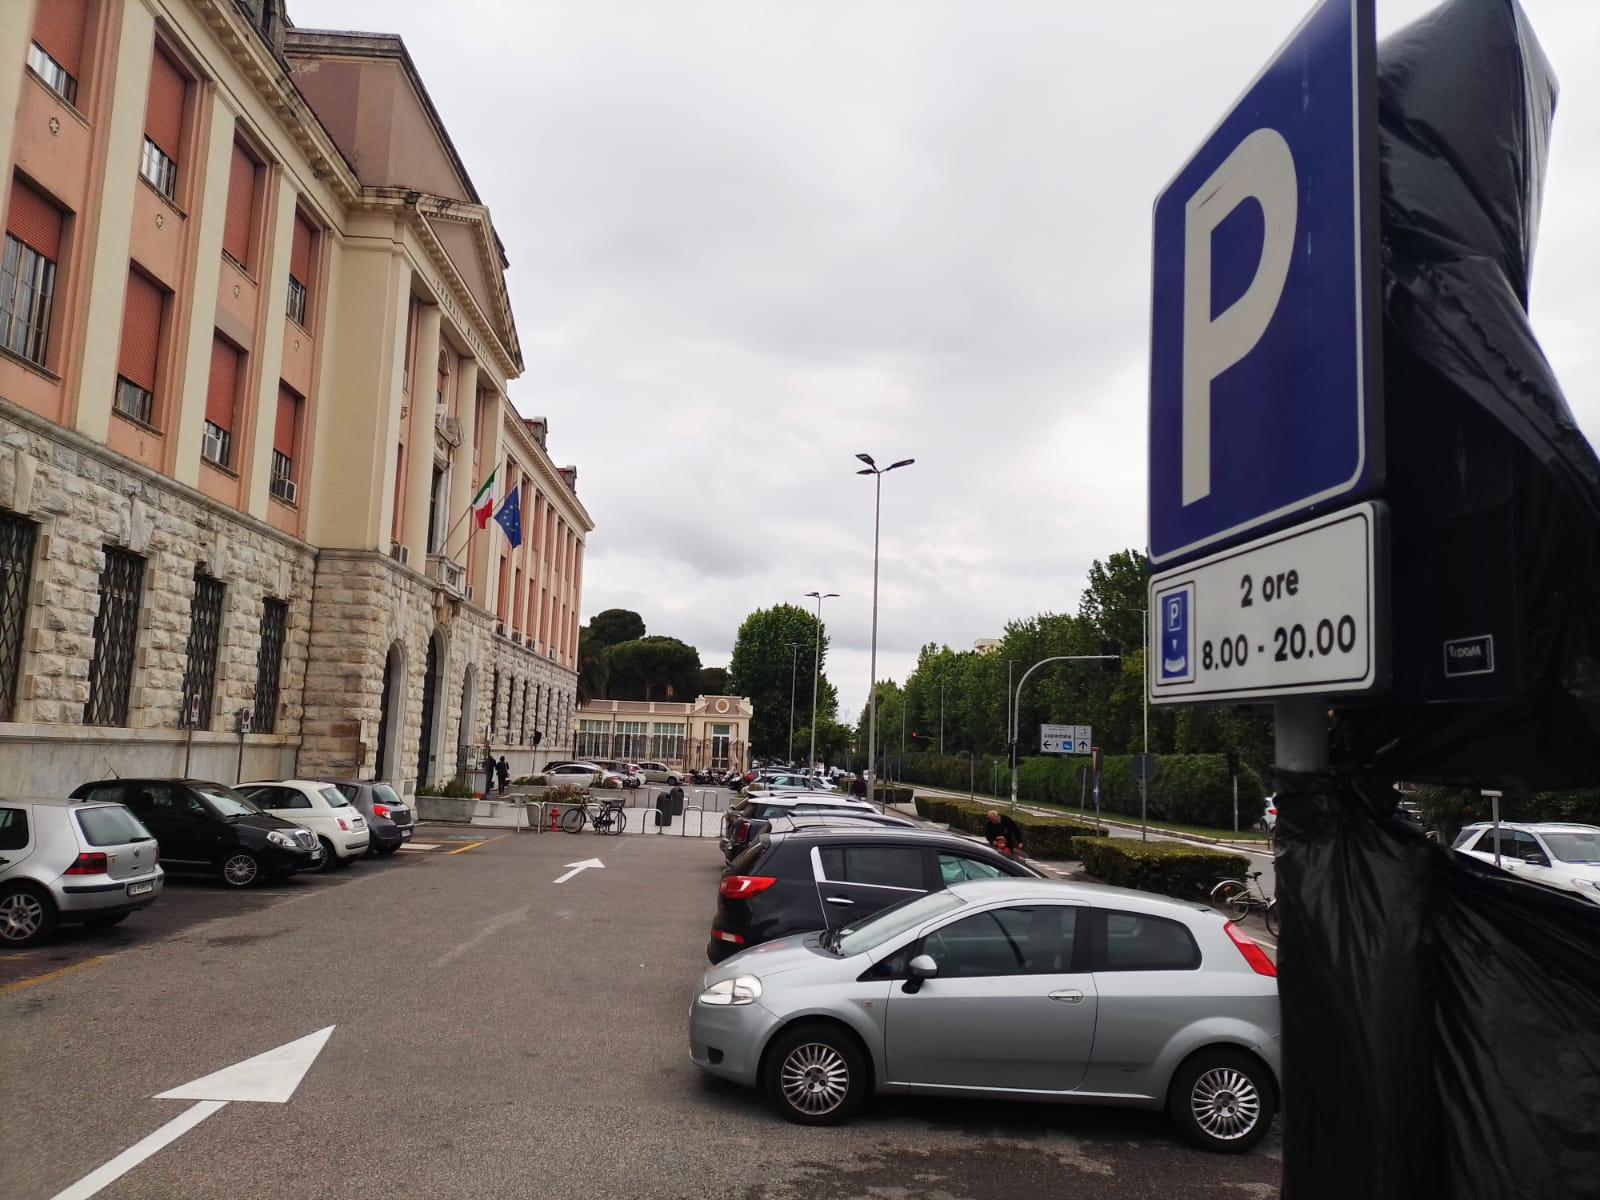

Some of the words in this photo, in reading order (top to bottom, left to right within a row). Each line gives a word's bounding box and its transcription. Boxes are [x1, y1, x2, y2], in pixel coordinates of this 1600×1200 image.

[1182, 127, 1298, 508] P
[1240, 574, 1253, 609] 2
[1262, 569, 1300, 602] ore
[1170, 602, 1179, 628] P
[1202, 634, 1249, 671] 8.00
[1274, 614, 1356, 662] 20.00
